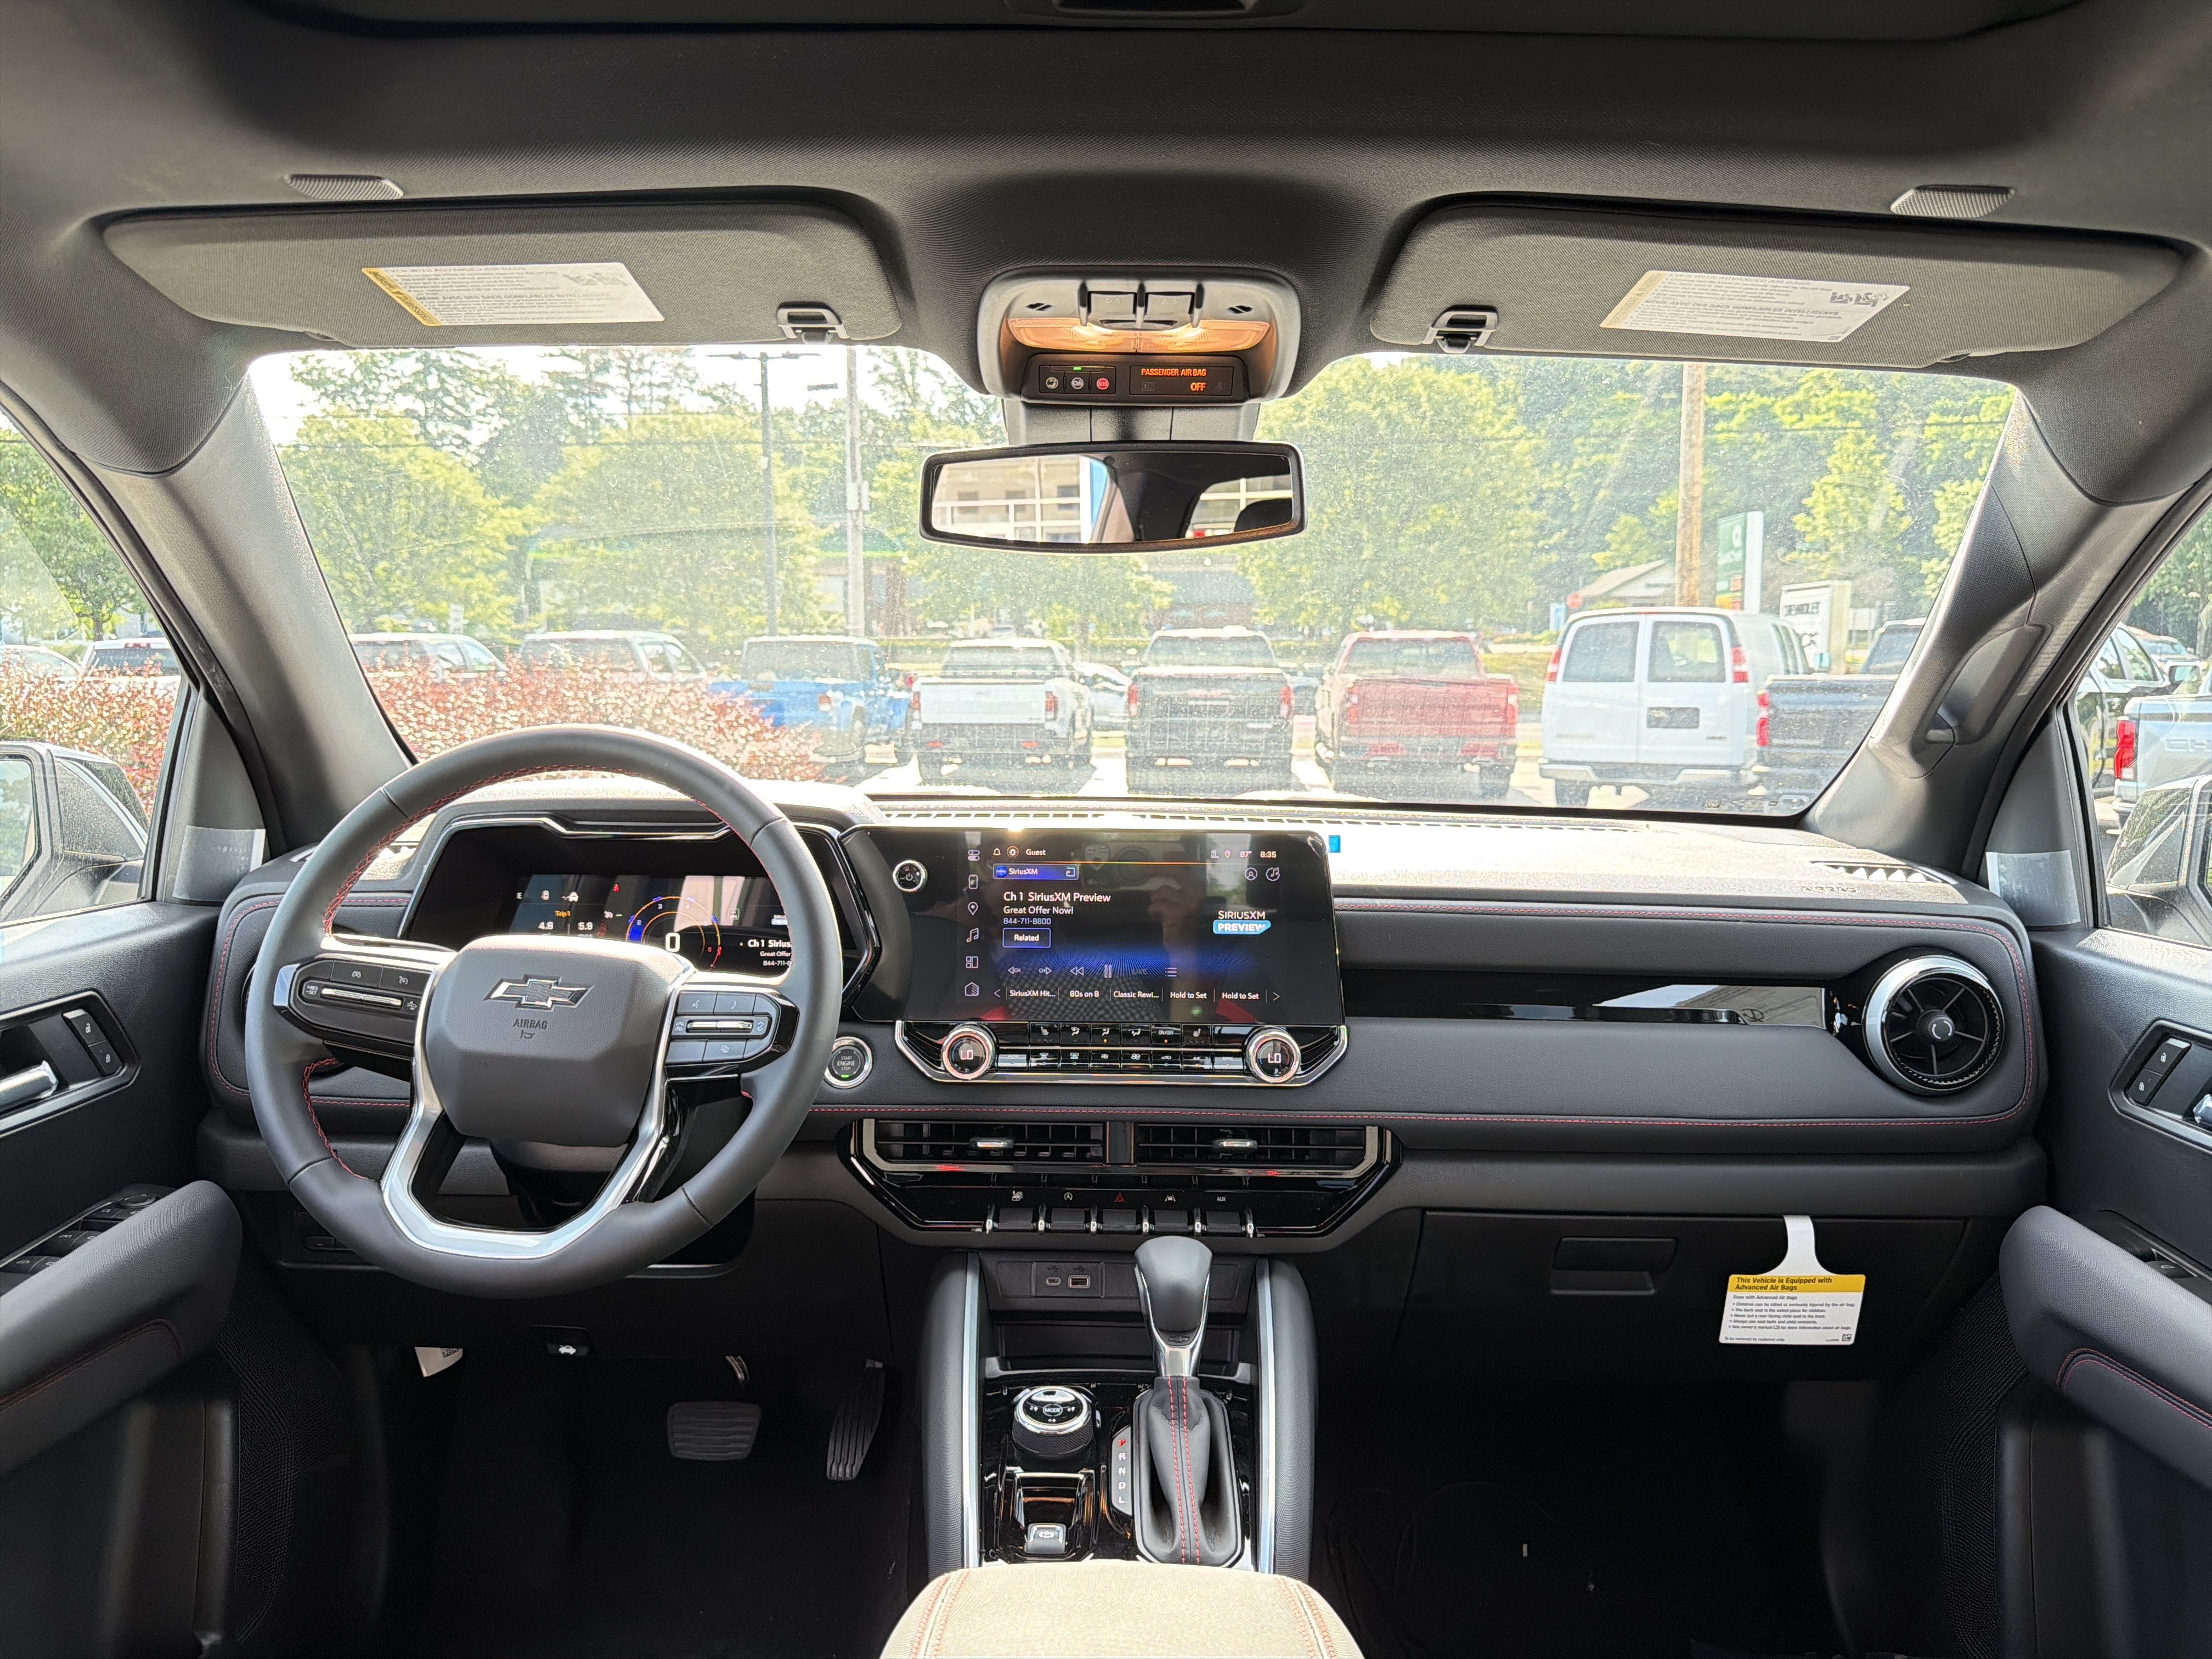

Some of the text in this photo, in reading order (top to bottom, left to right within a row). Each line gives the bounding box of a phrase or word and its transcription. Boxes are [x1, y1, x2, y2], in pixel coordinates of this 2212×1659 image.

[1141, 368, 1180, 376] PASSENGER
[1190, 382, 1206, 391] OFF
[1025, 848, 1046, 856] Guest
[1003, 891, 1111, 902] Ch 1 SiriusXM Preview
[1003, 906, 1074, 915] Great Offer Now!
[1218, 910, 1266, 919] SIRIUSXM
[578, 922, 593, 930] 5.9
[1003, 917, 1052, 926] 844-711-8800
[1217, 923, 1266, 932] PREVIEW
[665, 932, 681, 952] 0
[1014, 934, 1040, 942] Related
[747, 939, 760, 947] Ch
[760, 939, 765, 947] 1
[513, 1018, 548, 1029] AIRBAG
[1119, 1452, 1126, 1460] R
[1119, 1466, 1126, 1475] N
